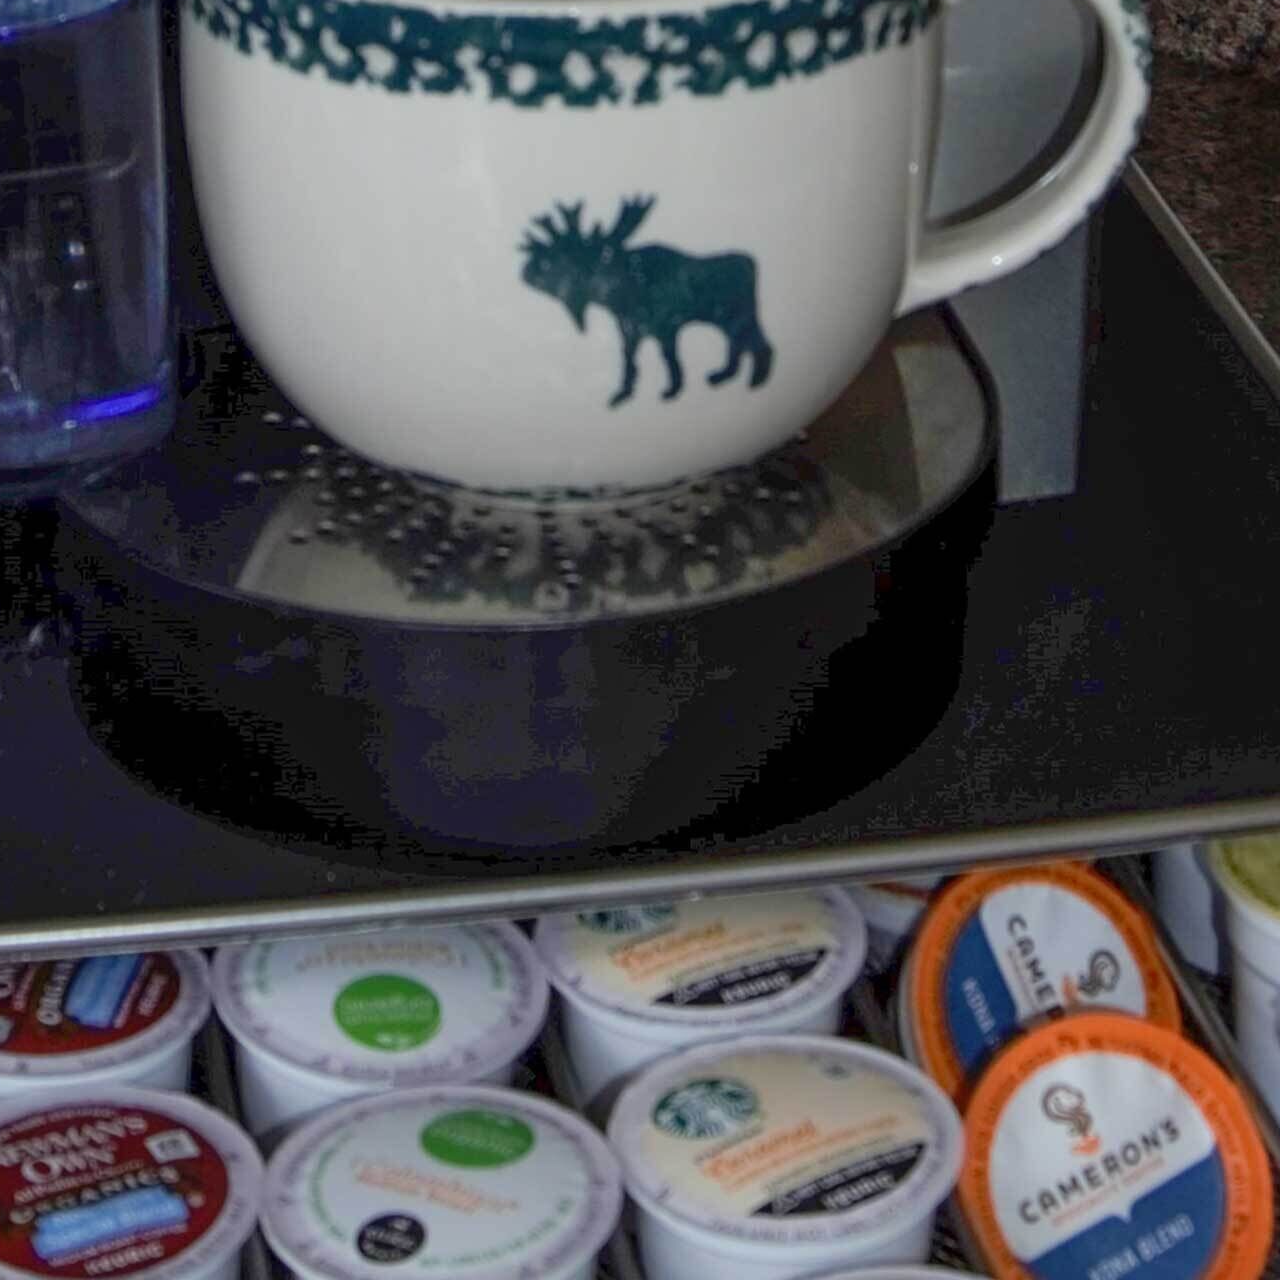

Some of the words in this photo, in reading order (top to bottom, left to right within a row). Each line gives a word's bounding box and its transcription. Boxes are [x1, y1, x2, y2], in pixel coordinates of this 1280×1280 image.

[10, 1166, 181, 1225] ORGANICS
[1018, 1116, 1182, 1224] CAMERON'S
[1137, 1212, 1196, 1263] BLEND
